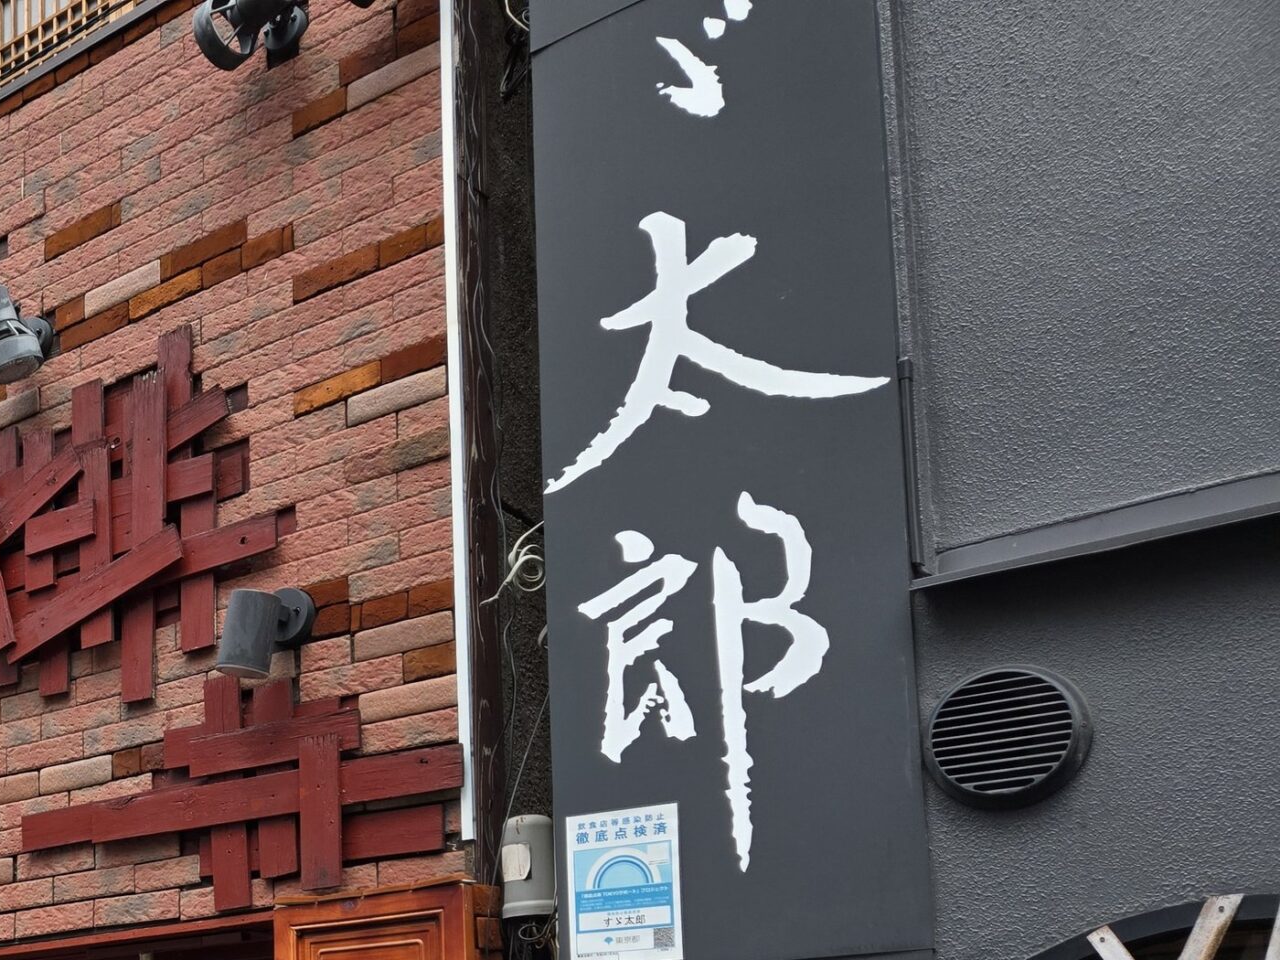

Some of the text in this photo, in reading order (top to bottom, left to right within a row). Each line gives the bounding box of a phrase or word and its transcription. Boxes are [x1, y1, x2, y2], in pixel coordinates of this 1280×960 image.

[577, 813, 664, 831] 飲食店等感染防止
[576, 822, 667, 844] 徹底点検済
[615, 935, 641, 944] 東京都
